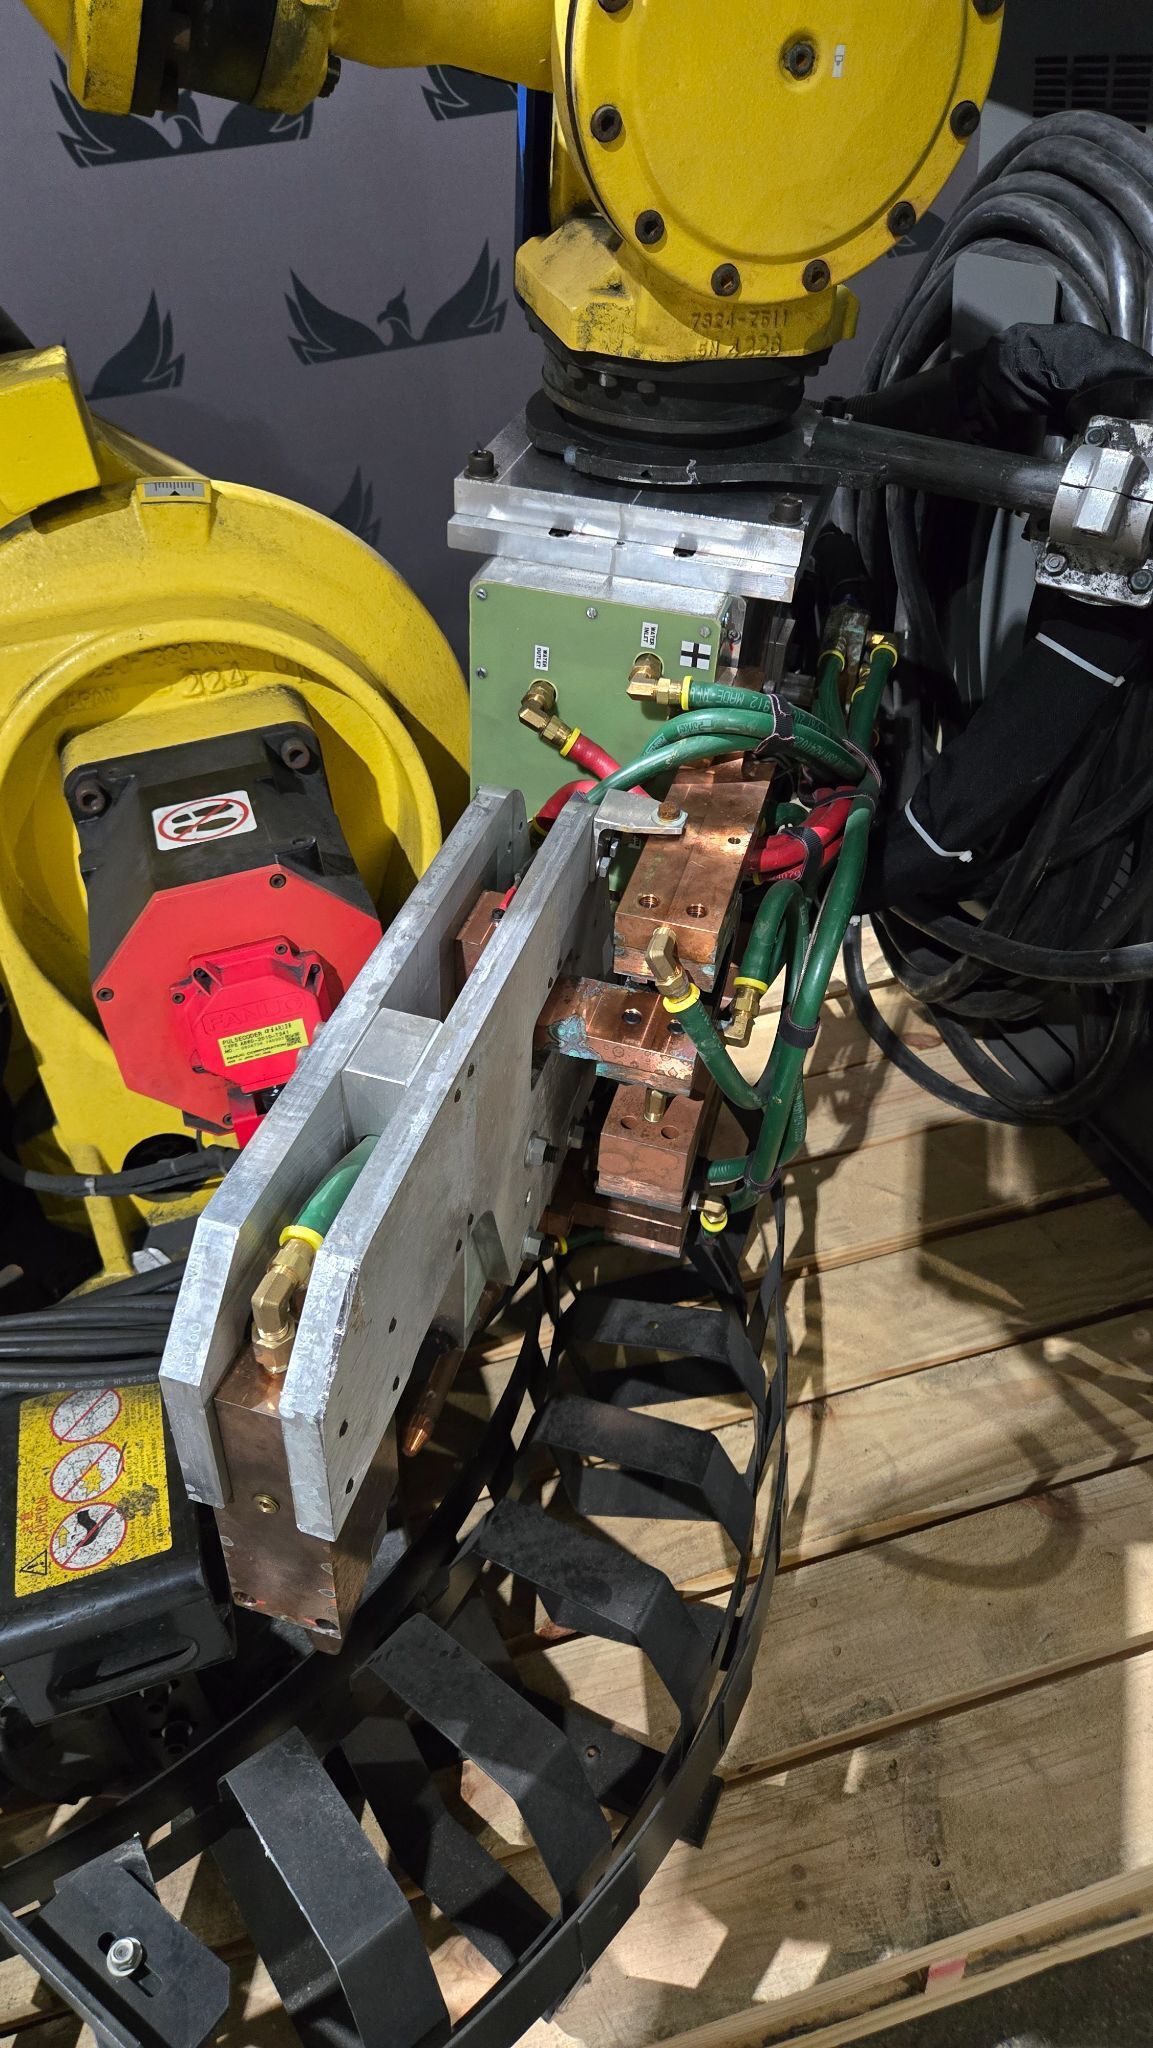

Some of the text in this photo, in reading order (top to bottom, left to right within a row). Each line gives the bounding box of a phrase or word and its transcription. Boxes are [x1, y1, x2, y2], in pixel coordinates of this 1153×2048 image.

[717, 689, 745, 705] MADE
[210, 999, 303, 1032] FANUC
[221, 1030, 262, 1045] PULSECODER
[35, 1495, 49, 1541] CAUTION
